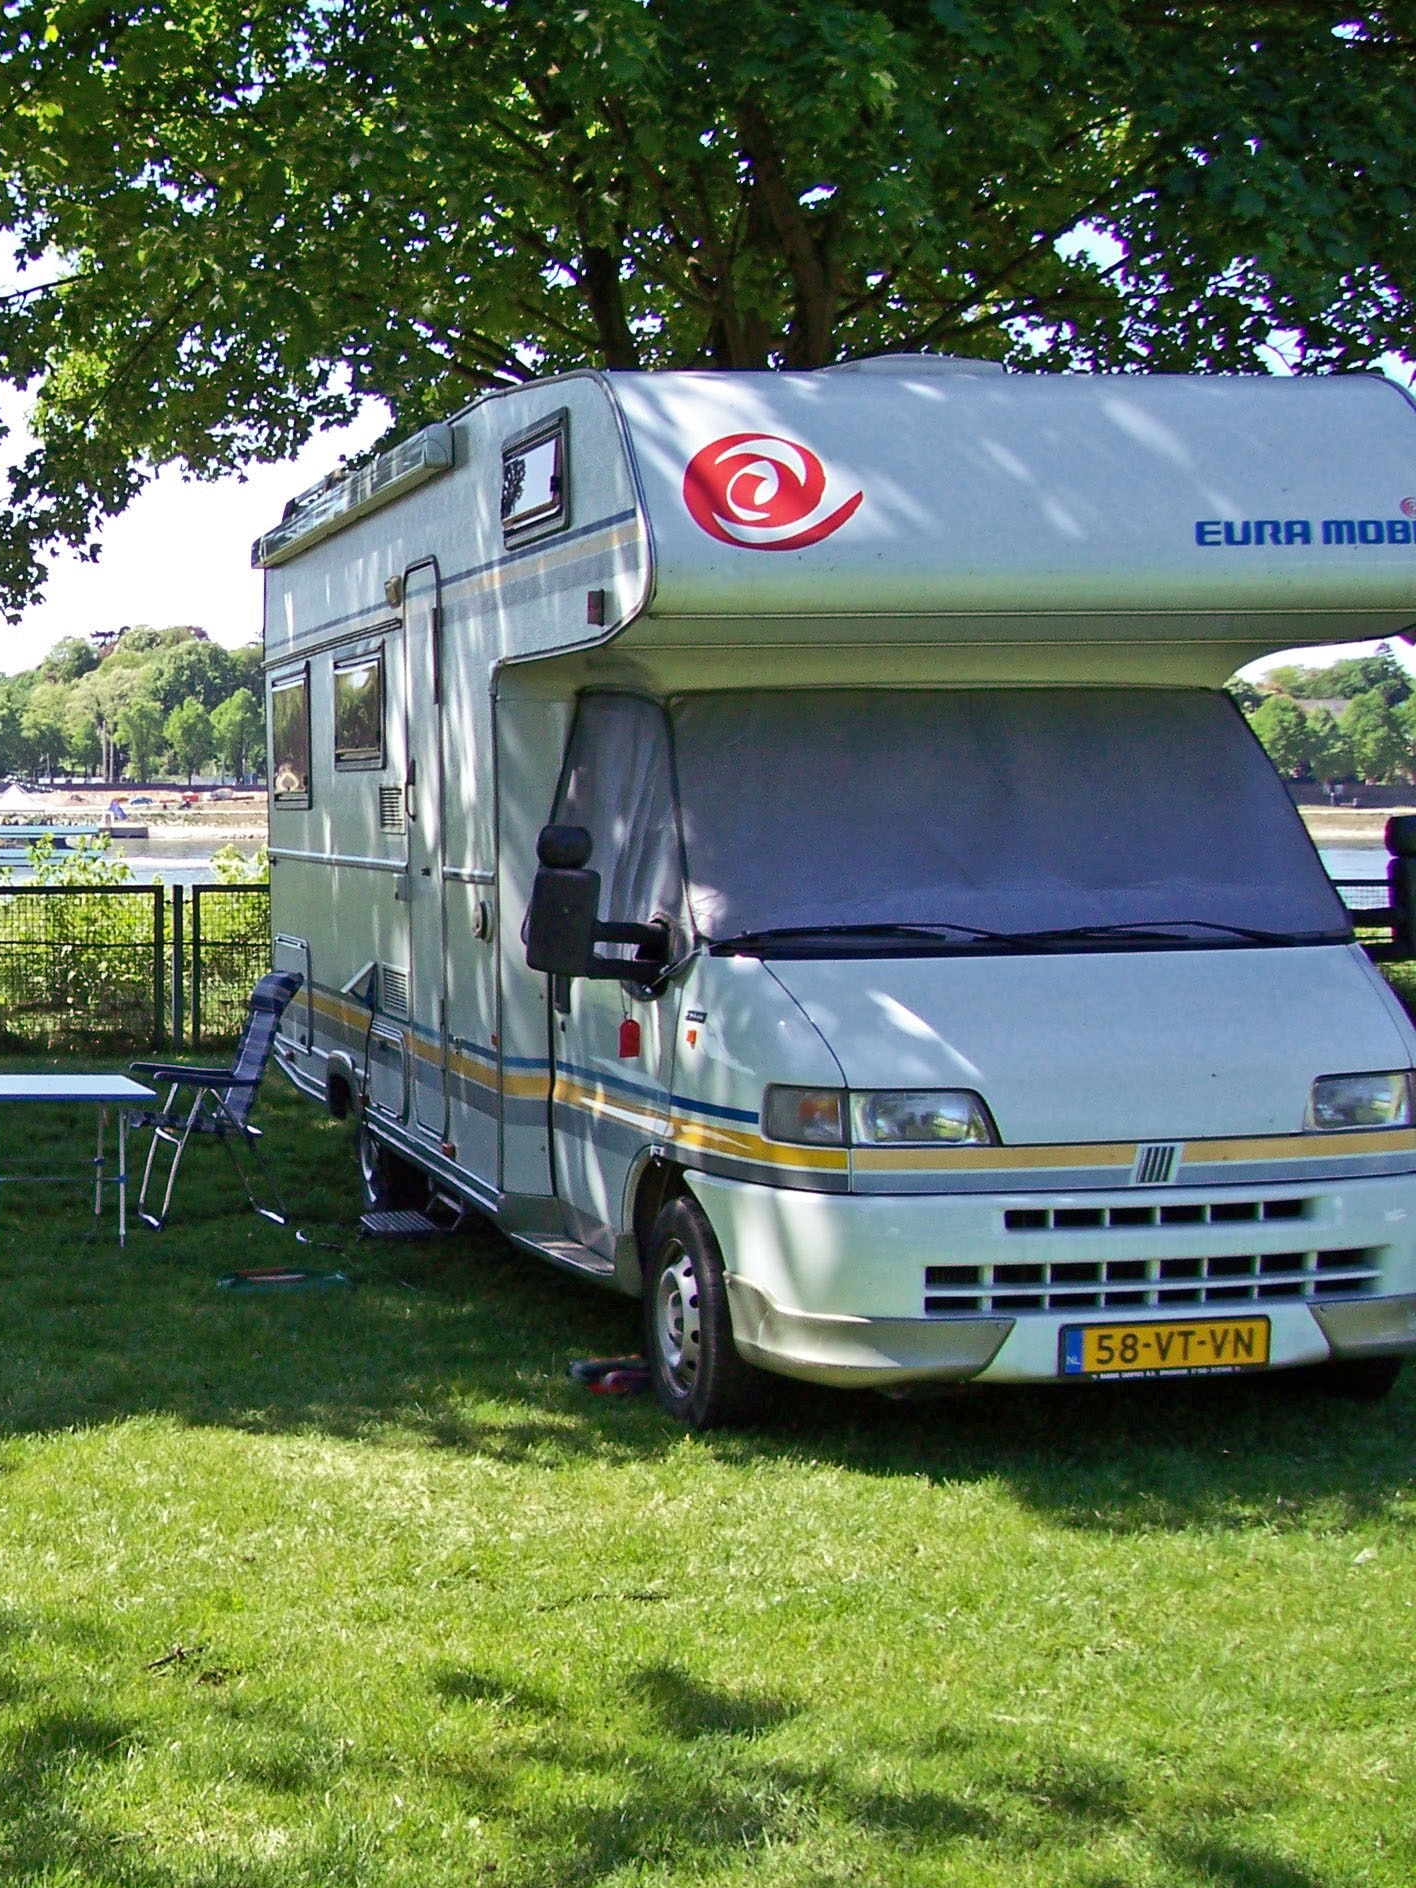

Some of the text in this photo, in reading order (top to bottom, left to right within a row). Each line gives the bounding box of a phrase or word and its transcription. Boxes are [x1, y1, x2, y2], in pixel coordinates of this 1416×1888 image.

[1195, 519, 1416, 547] EURA MOB
[1066, 1354, 1081, 1366] NL
[1096, 1328, 1254, 1364] 58-VT-VN
